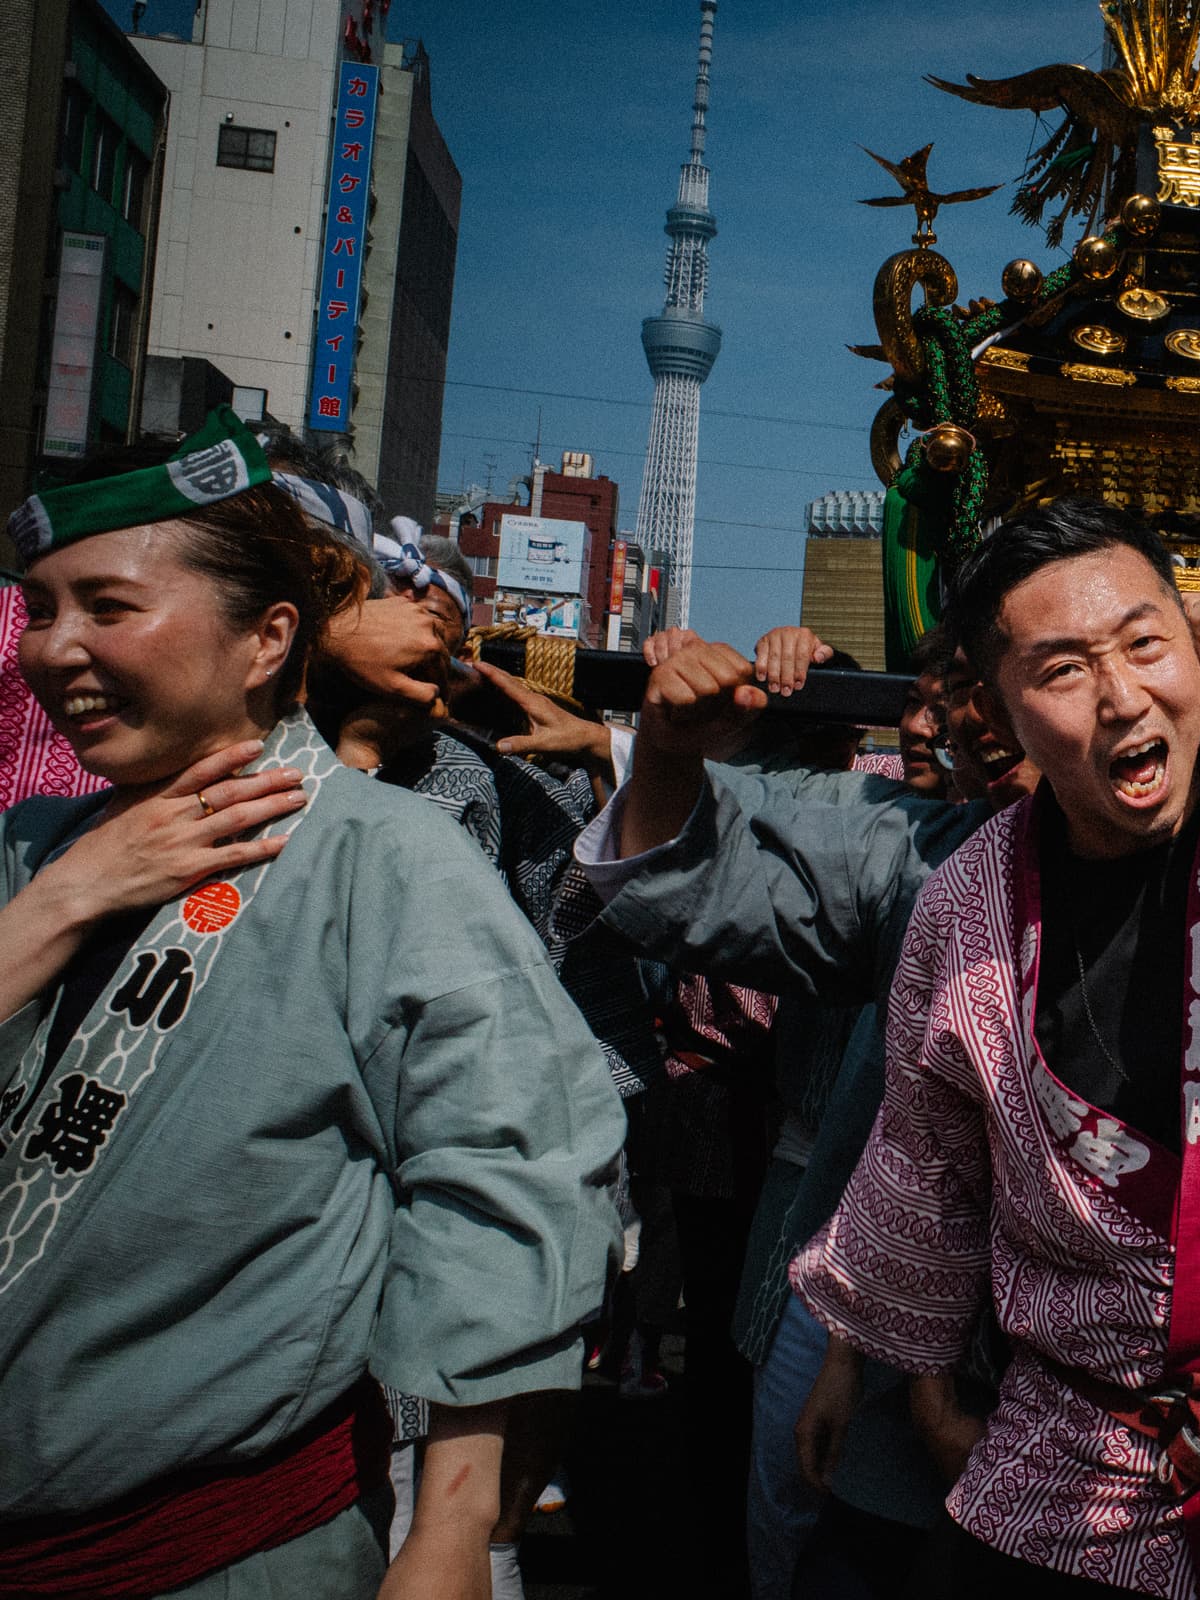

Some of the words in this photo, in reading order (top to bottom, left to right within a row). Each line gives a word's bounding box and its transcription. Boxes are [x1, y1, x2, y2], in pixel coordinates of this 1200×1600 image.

[319, 76, 368, 419] カラオケ&パーティー館
